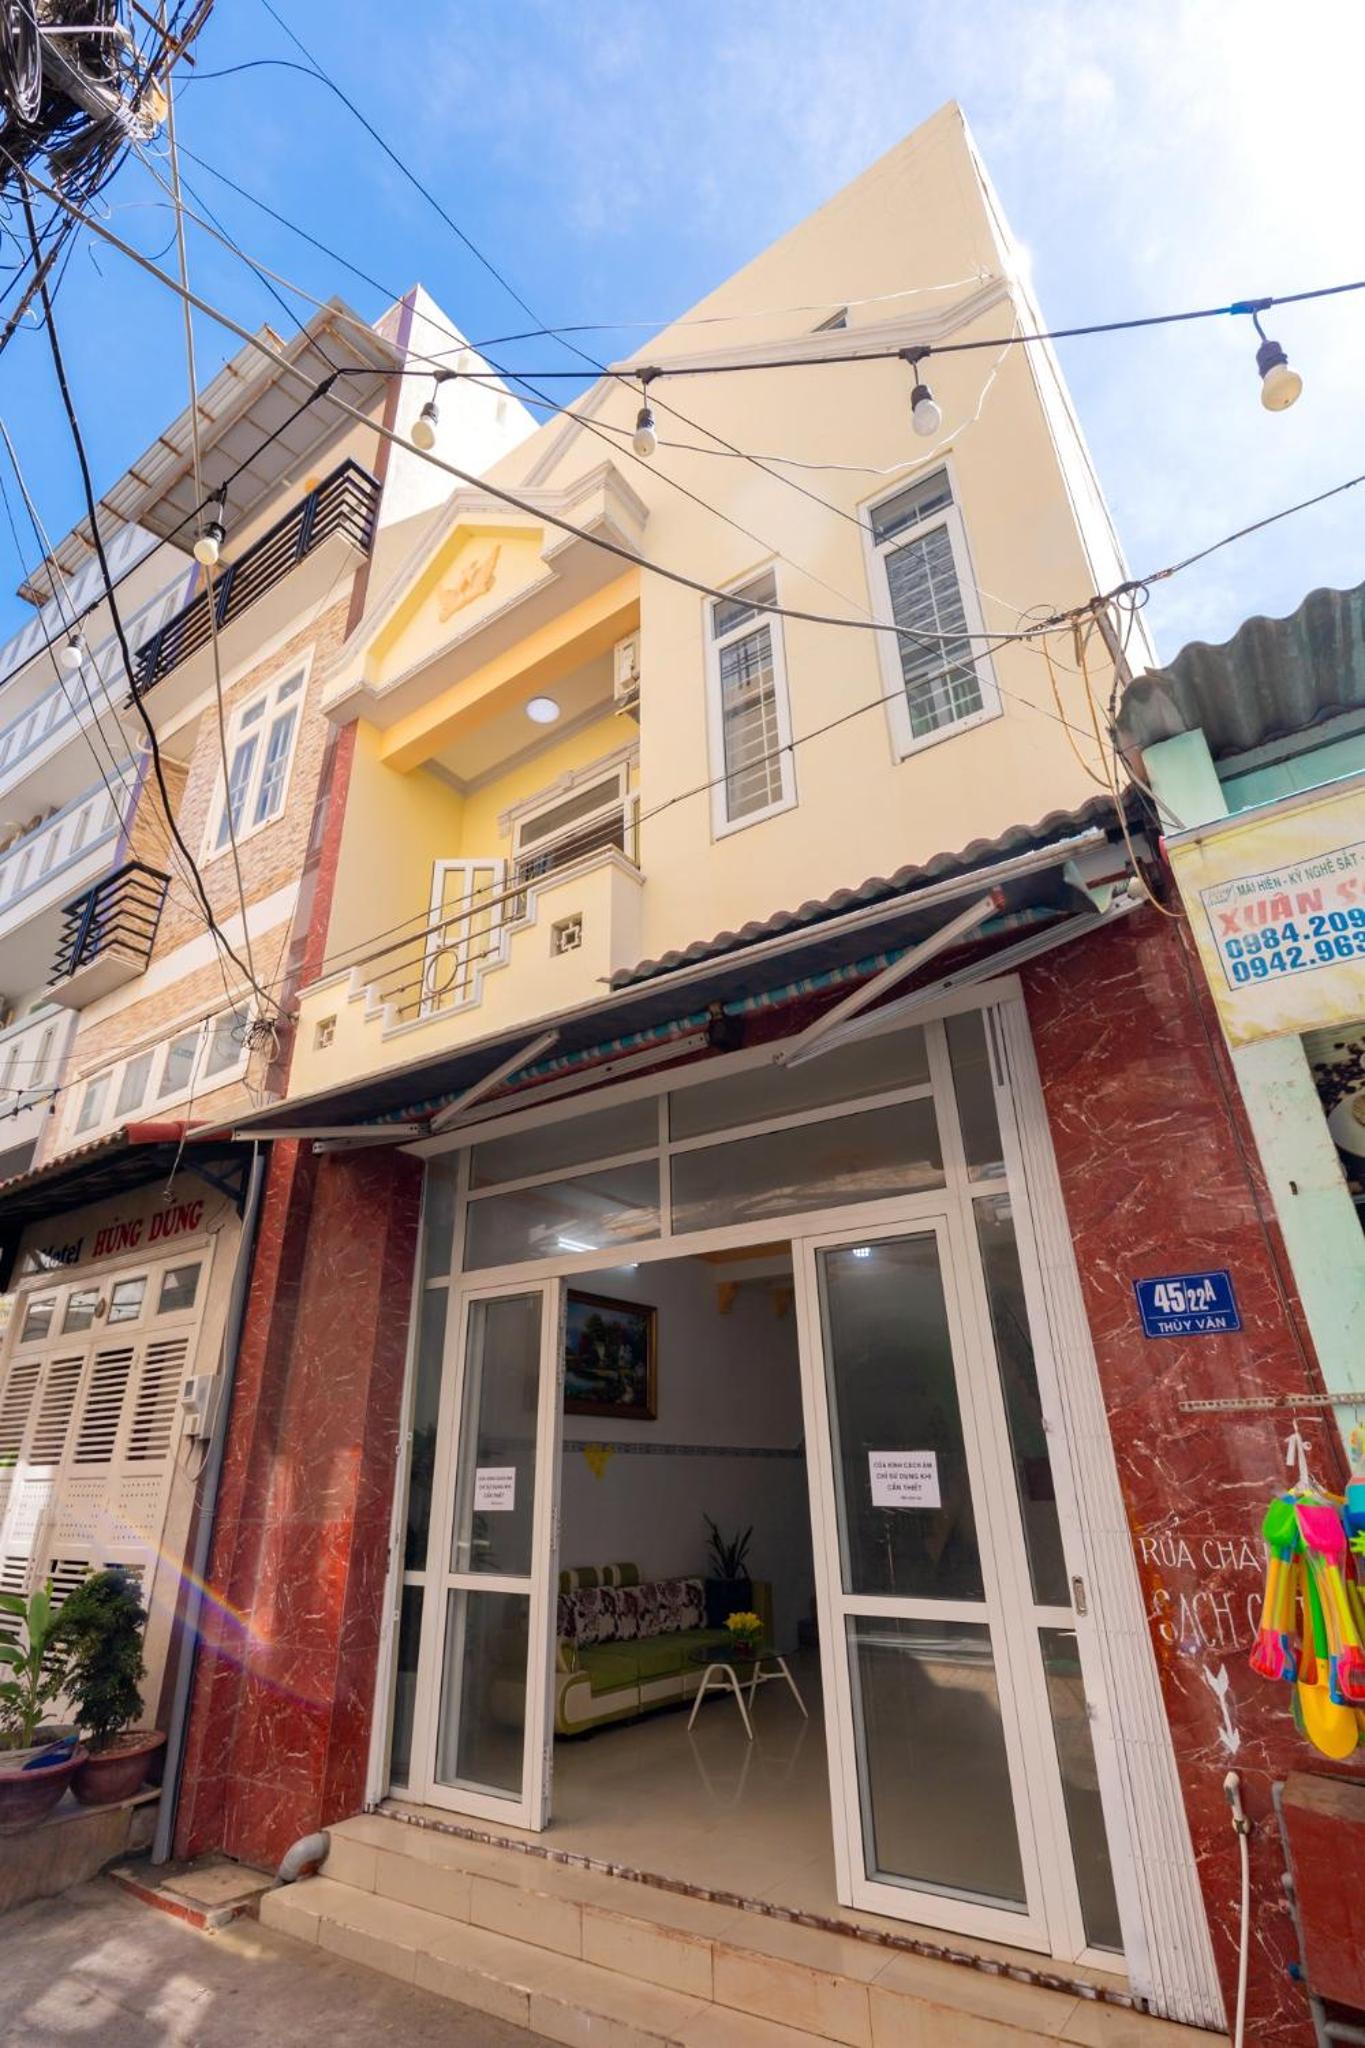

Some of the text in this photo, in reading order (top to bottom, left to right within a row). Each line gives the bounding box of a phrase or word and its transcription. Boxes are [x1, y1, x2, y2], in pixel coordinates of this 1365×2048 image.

[1218, 888, 1324, 937] XUÂN
[1336, 876, 1365, 905] S
[1225, 907, 1365, 959] 0984.209
[1231, 930, 1365, 983] 0942.963
